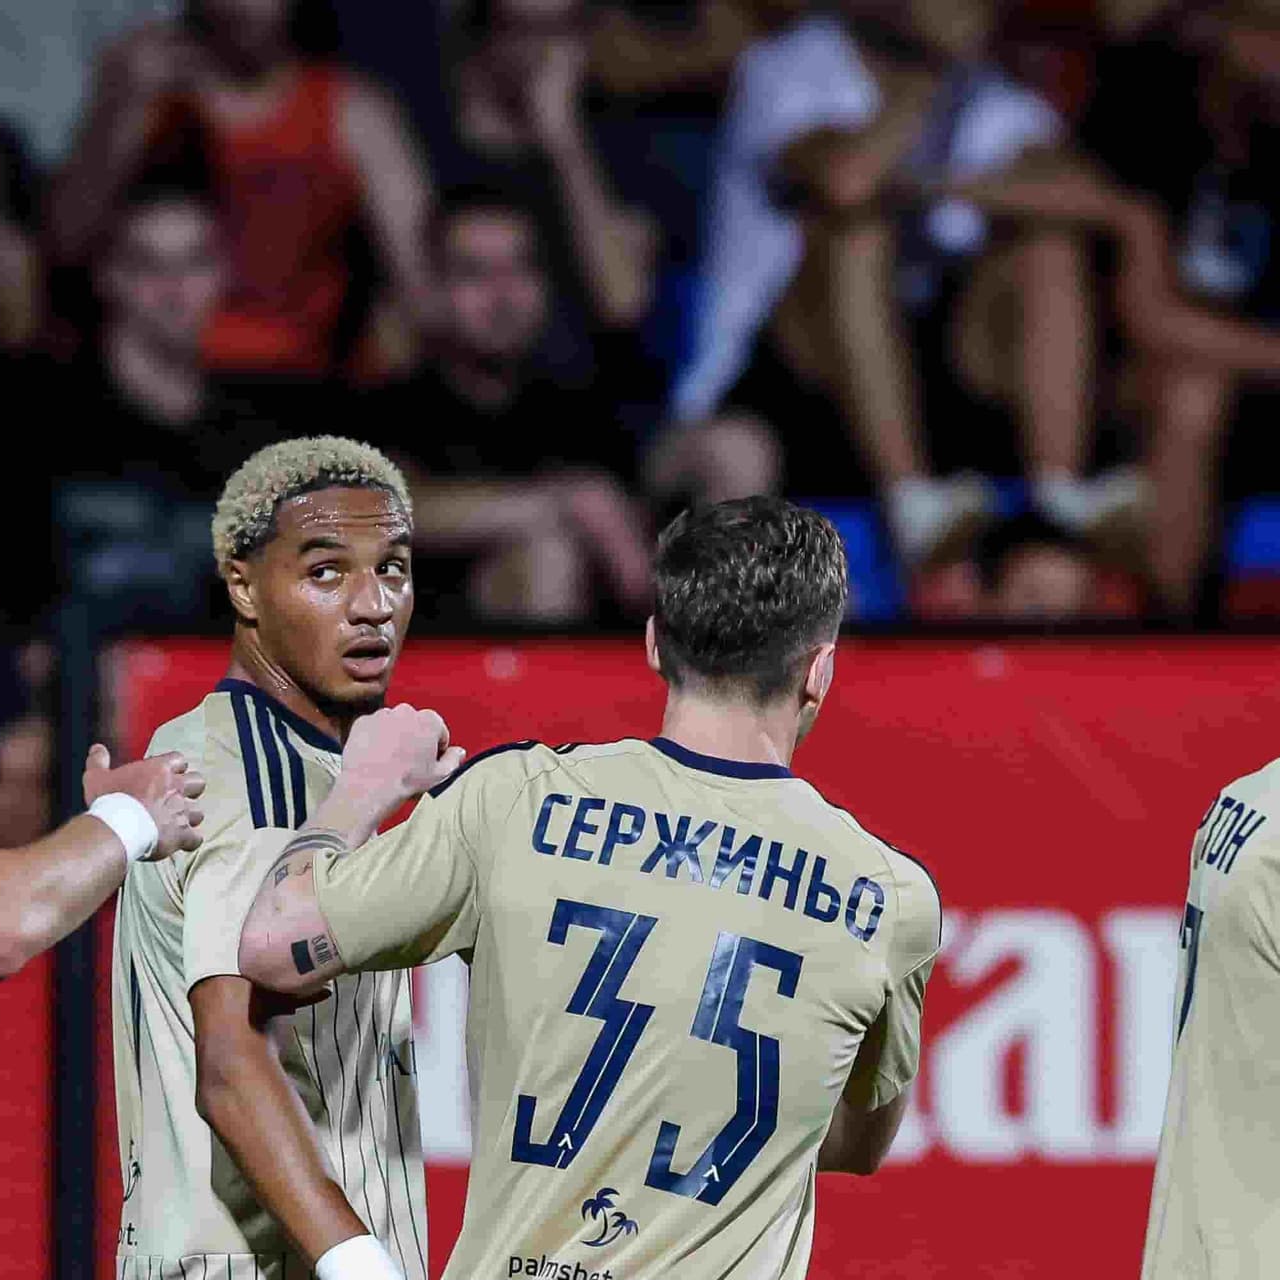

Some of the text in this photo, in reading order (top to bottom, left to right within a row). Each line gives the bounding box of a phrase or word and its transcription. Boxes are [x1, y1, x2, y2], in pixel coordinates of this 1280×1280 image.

[531, 793, 886, 943] СЕРЖИНЬО
[1197, 796, 1267, 874] ТОН
[510, 898, 804, 1207] 35
